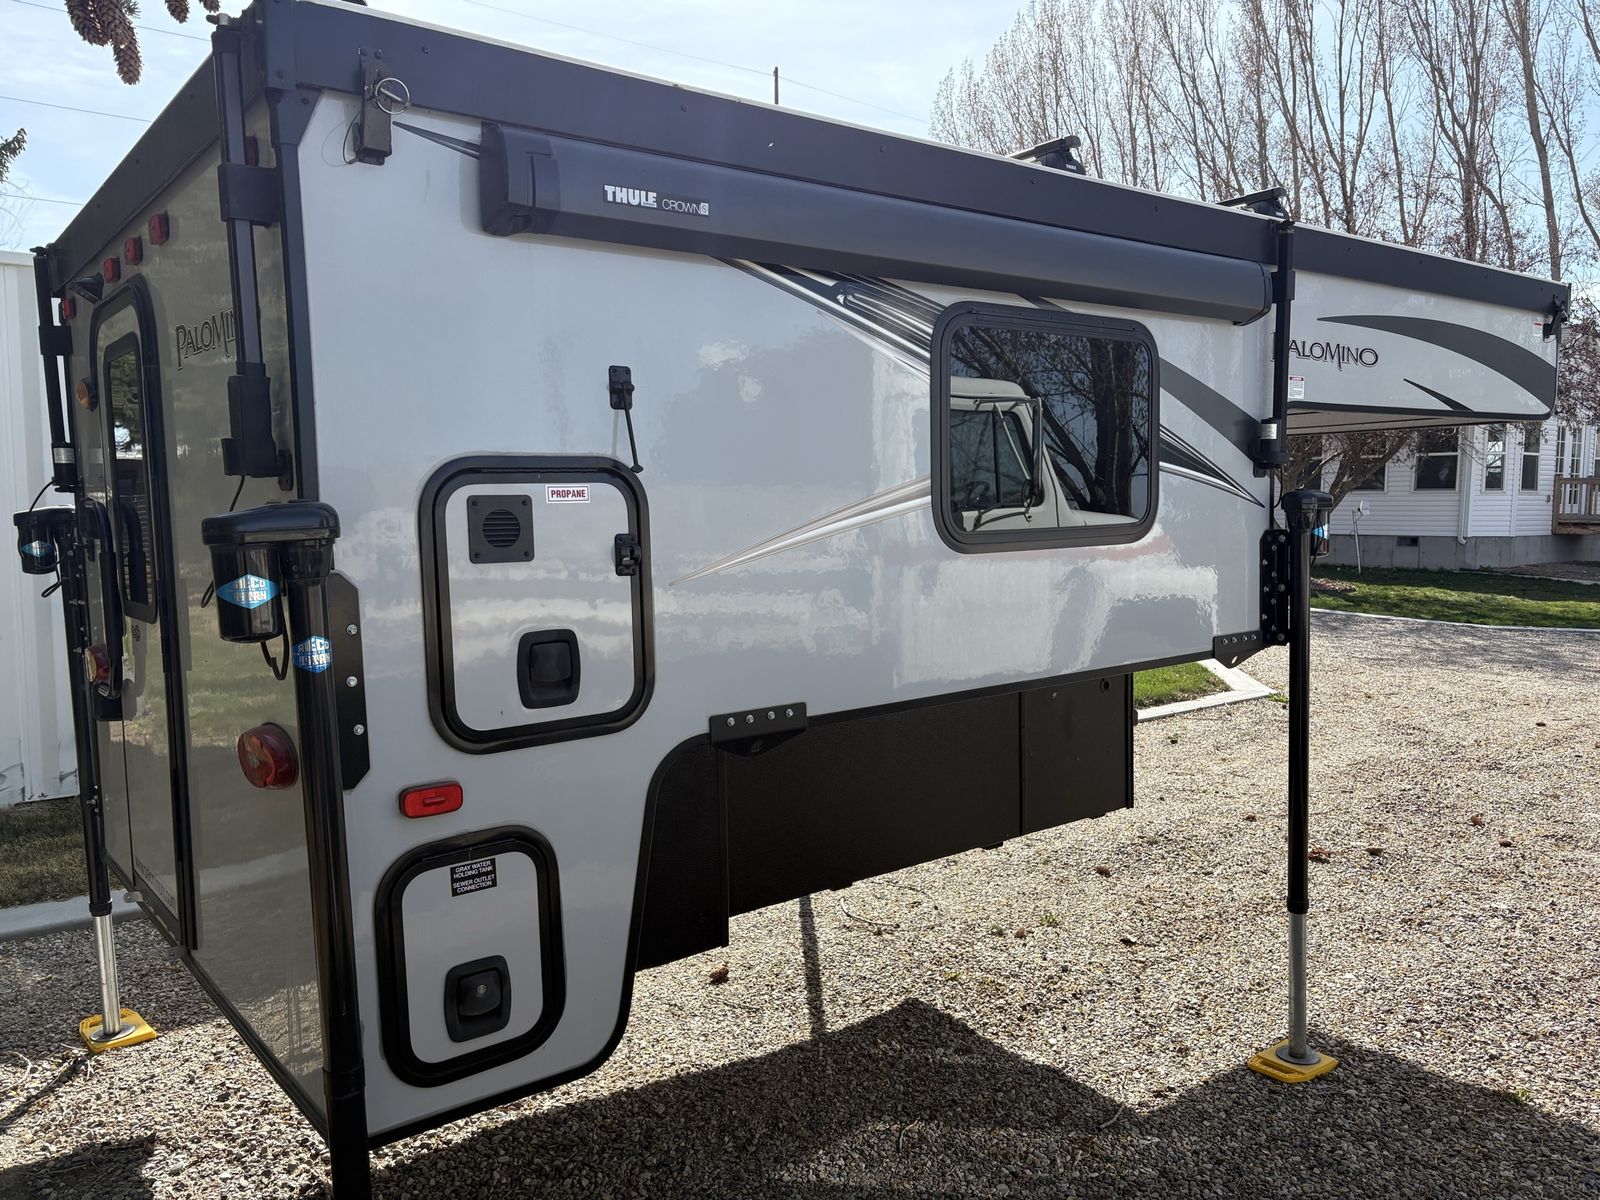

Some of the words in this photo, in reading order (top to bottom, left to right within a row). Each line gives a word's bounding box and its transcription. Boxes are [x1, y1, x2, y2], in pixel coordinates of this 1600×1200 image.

[604, 185, 658, 209] THULE
[176, 308, 236, 371] PALOMI
[1288, 339, 1378, 372] ALOMINO
[551, 489, 586, 498] PROPANE
[455, 865, 471, 873] GRAY
[472, 861, 491, 869] WATER
[454, 869, 478, 879] HOLDING
[453, 880, 473, 888] SEWER
[474, 874, 495, 883] OUTLET
[457, 881, 492, 893] CONNECTION
